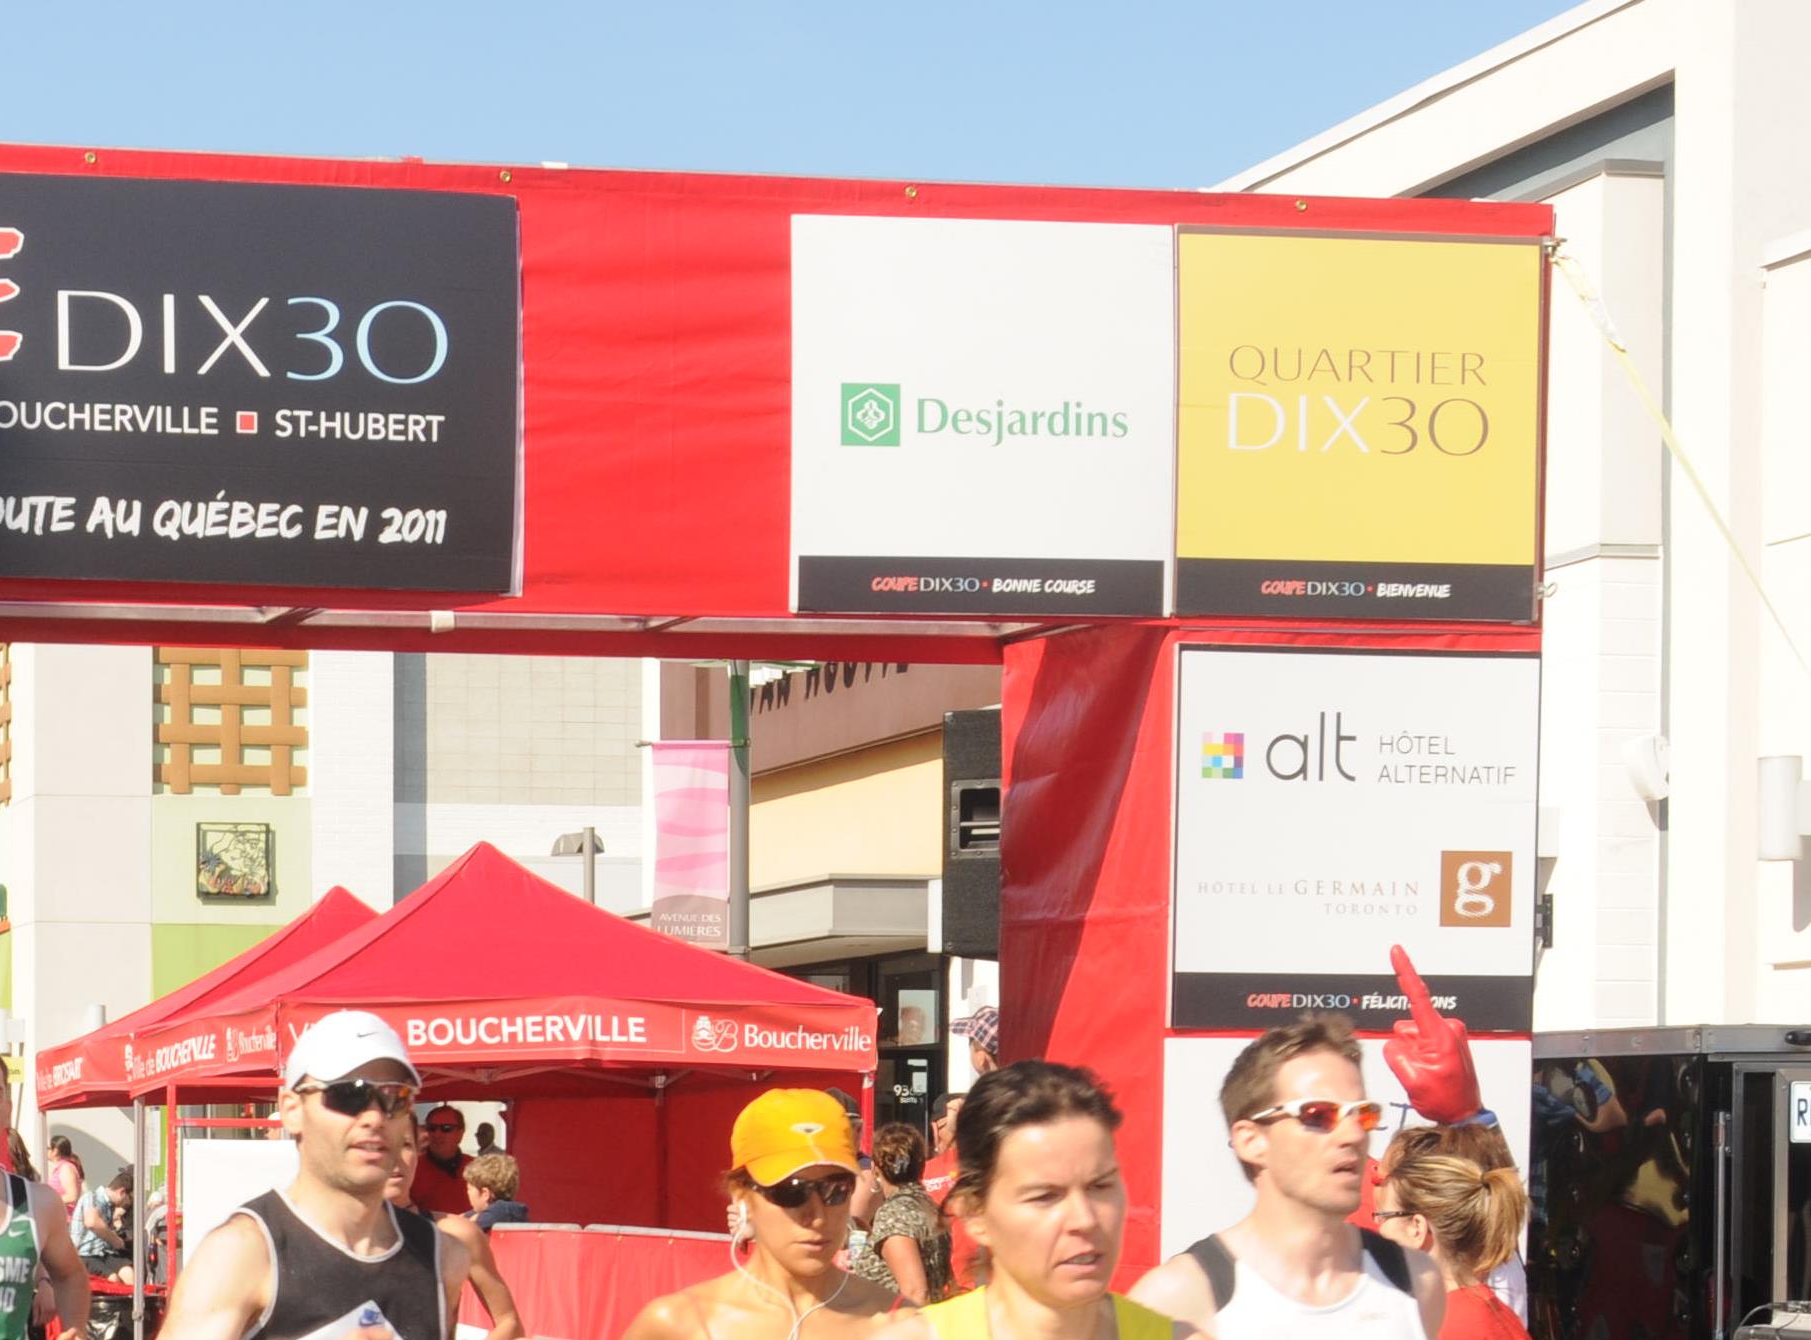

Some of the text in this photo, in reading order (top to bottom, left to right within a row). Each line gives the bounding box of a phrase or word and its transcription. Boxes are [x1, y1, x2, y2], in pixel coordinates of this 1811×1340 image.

[57, 289, 448, 386] DIX30
[1227, 344, 1489, 387] QUARTIER
[274, 409, 445, 442] ST-HUBERT
[916, 397, 1130, 447] Desjardins
[1226, 392, 1491, 458] DIX30
[85, 496, 142, 539] AU
[152, 489, 303, 541] QUÉBEC
[314, 504, 368, 542] EN
[378, 507, 447, 545] 2011
[992, 578, 1042, 595] BONNE
[1044, 578, 1096, 596] COURSE
[1376, 582, 1451, 600] BIENVENUE
[1266, 711, 1357, 782] alt
[1379, 730, 1455, 756] HÔTEL
[1377, 765, 1516, 785] ALTERNATIF
[1294, 880, 1419, 897] GERMAIN
[1453, 859, 1503, 919] g
[659, 912, 721, 923] AVENUE DES
[1323, 903, 1419, 916] TORONTO
[1362, 993, 1457, 1010] FÉLICITONS
[407, 1015, 648, 1046] BOUCHERVILLE
[745, 1024, 872, 1051] Boucherville
